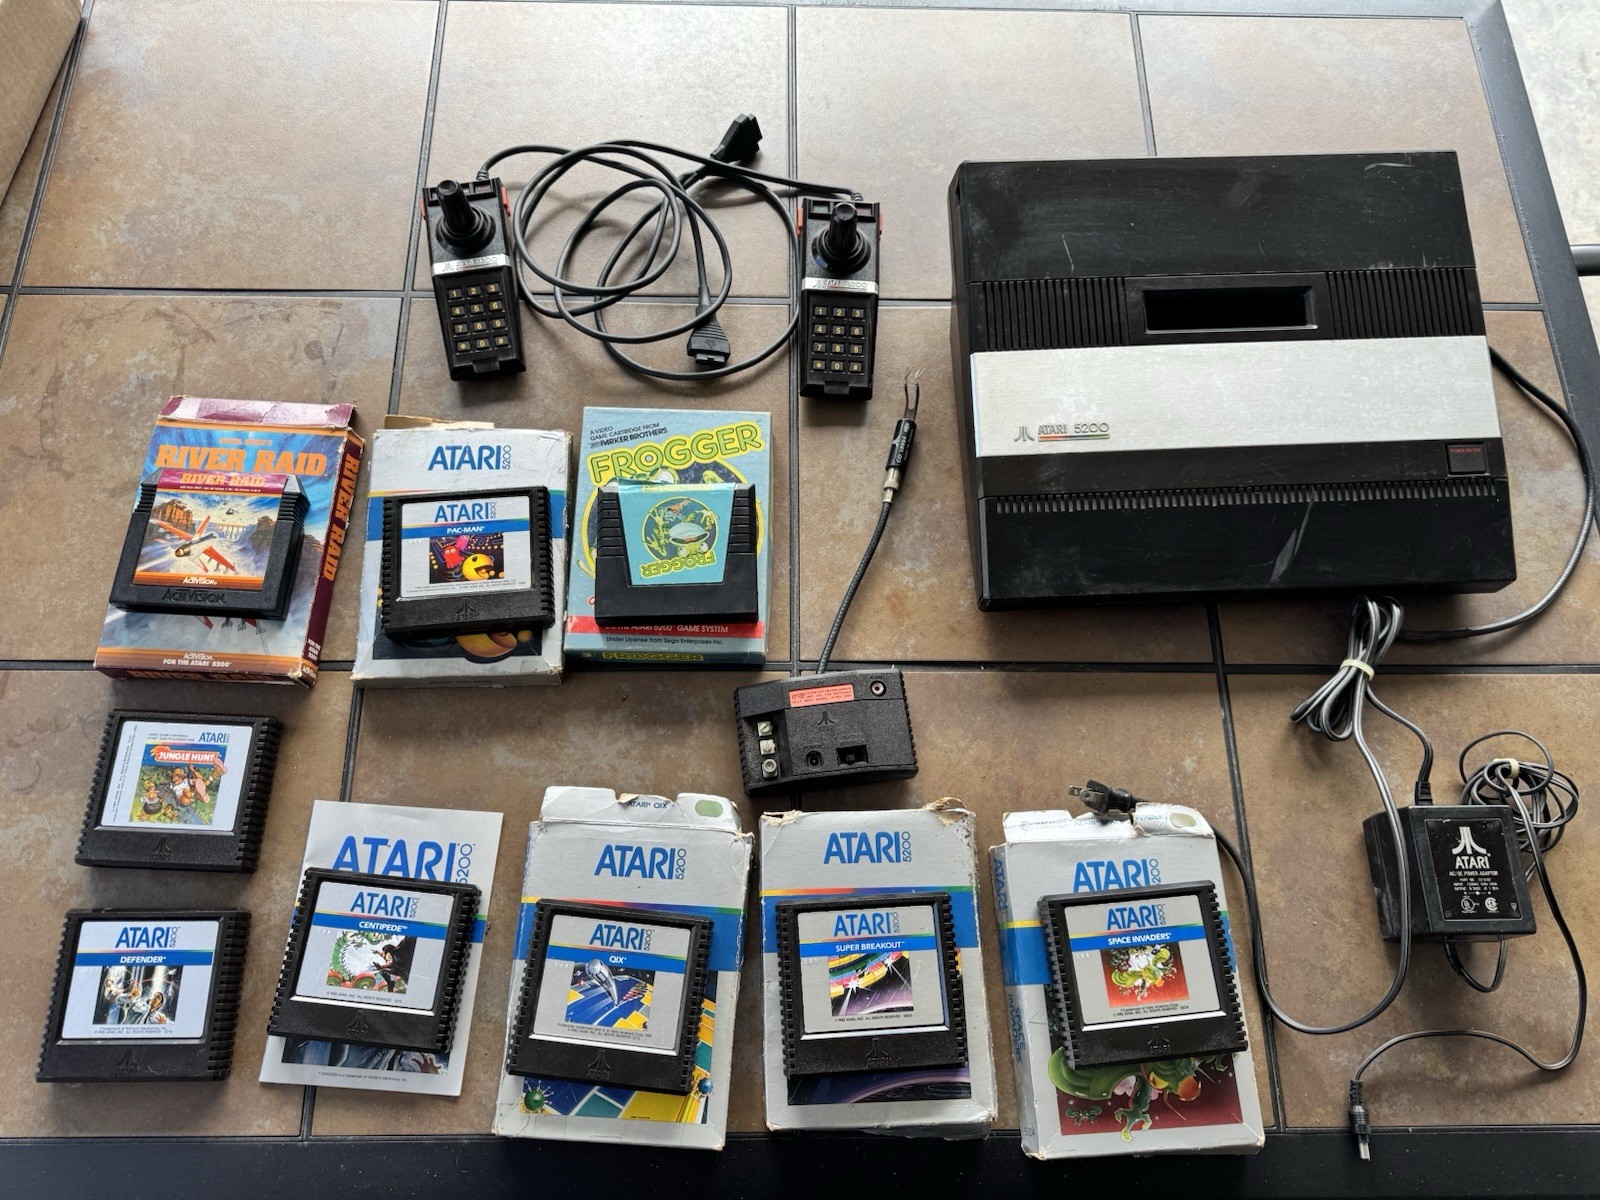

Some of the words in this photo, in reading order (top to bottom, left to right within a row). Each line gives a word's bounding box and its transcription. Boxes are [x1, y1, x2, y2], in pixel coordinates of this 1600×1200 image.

[600, 435, 629, 446] PARKER
[629, 427, 668, 440] BROTHERS
[609, 427, 641, 437] CARTRIDGE
[1038, 424, 1067, 434] ATARI
[1074, 423, 1109, 433] 5200
[155, 445, 246, 472] RIVER
[253, 450, 327, 476] RAID
[428, 445, 500, 471] ATARI
[502, 445, 511, 470] 5200
[591, 424, 761, 483] FROGGER
[180, 473, 226, 486] RIVER
[229, 475, 266, 487] RAID
[335, 452, 360, 522] RIVER
[434, 502, 489, 522] ATARI
[323, 524, 346, 581] RAID
[641, 550, 715, 577] FROGGER
[603, 652, 704, 662] FROGGER
[199, 733, 226, 743] ATARI
[158, 752, 189, 760] JUNGLE
[192, 752, 215, 761] HUNT
[332, 836, 456, 882] ATARI
[455, 843, 472, 884] 5200
[824, 832, 900, 864] ATARI
[902, 831, 912, 863] 5200
[594, 844, 676, 880] ATARI
[676, 848, 686, 880] 5200
[1456, 856, 1490, 869] ATARI
[994, 858, 1008, 910] ATARI
[1072, 858, 1150, 893] ATARI
[1150, 858, 1162, 885] 200
[350, 891, 410, 918] ATARI
[409, 898, 418, 918] 5200
[359, 921, 401, 932] CENTIPEDE
[834, 913, 892, 937] ATARI
[1107, 905, 1157, 930] ATARI
[1158, 906, 1166, 925] 5200
[115, 927, 170, 948] ATARI
[169, 927, 178, 948] 5200
[589, 924, 644, 950] ATARI
[644, 929, 652, 951] 5200
[836, 944, 860, 952] SUPER
[862, 942, 901, 951] BREAKOUT
[1108, 936, 1130, 945] SPACE
[1132, 933, 1169, 944] INVADERS
[1008, 994, 1022, 1063] INVADERS
[1014, 1000, 1026, 1050] SPACE
